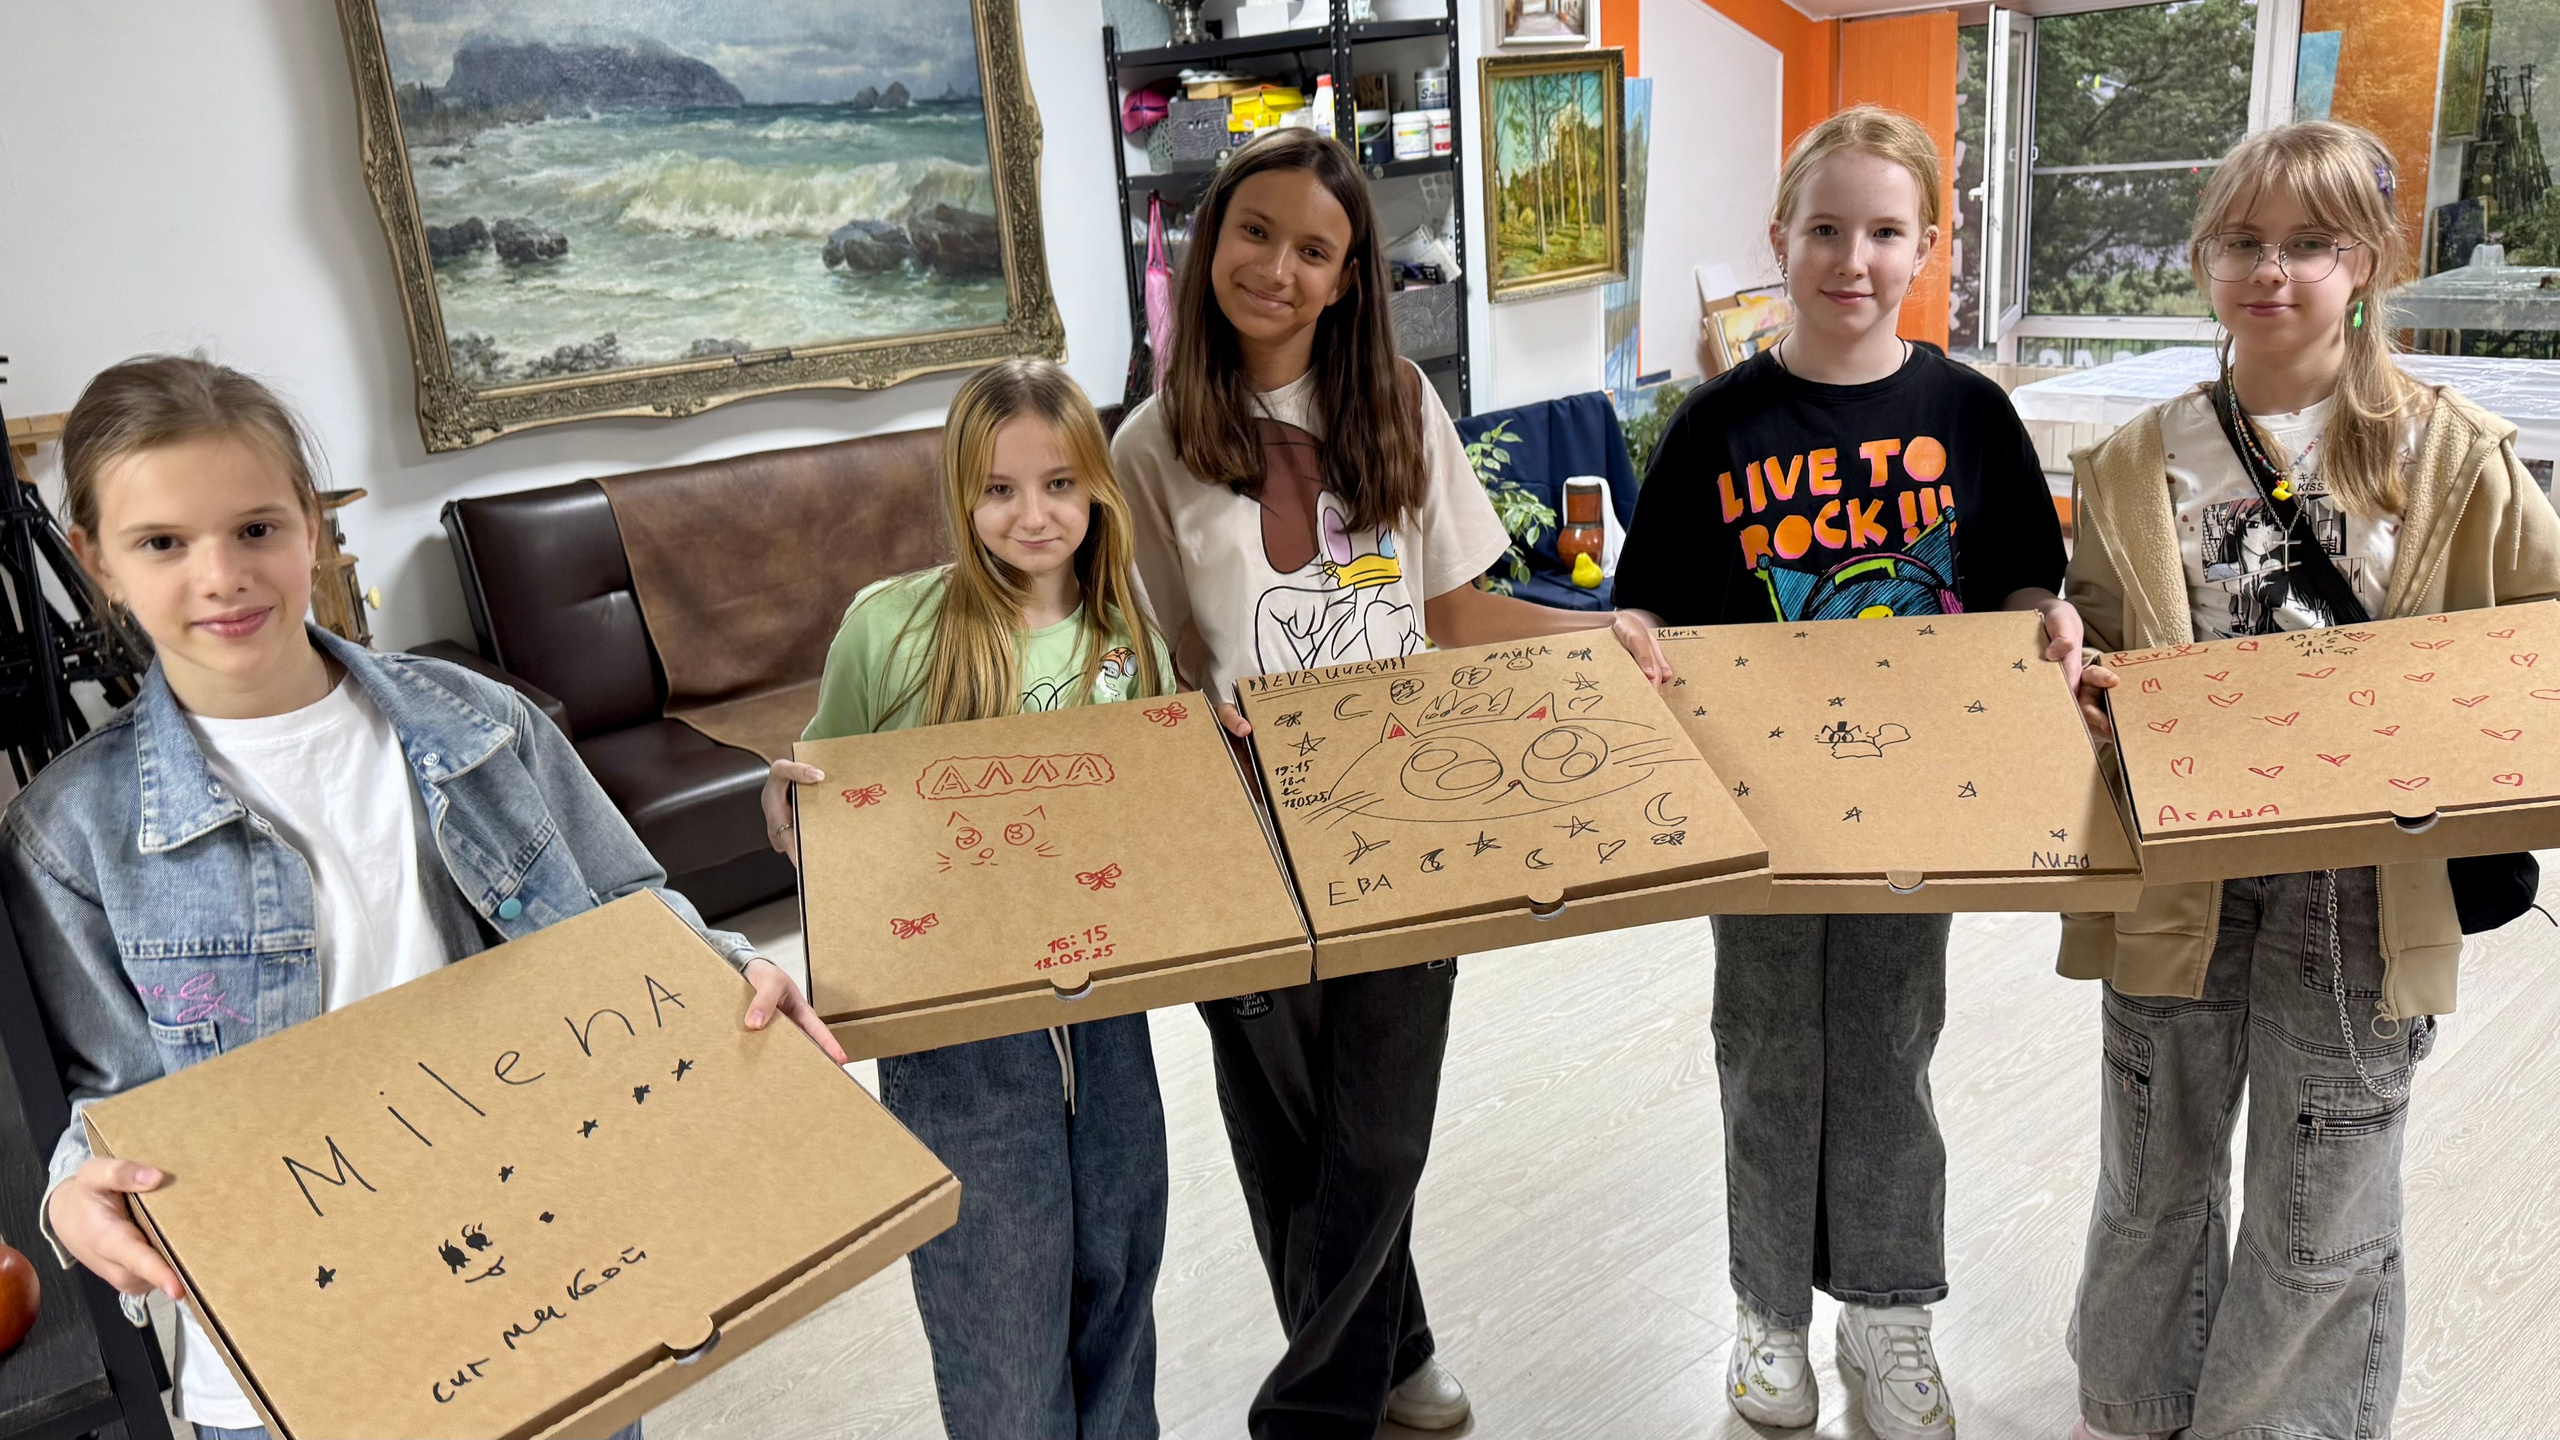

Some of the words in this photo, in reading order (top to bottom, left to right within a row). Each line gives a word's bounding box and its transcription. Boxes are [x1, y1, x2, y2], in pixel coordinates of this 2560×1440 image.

[1717, 447, 1842, 524] LIVE
[1859, 435, 1947, 487] TO
[1275, 759, 1314, 776] 19:15
[1033, 943, 1117, 970] 18.05.25
